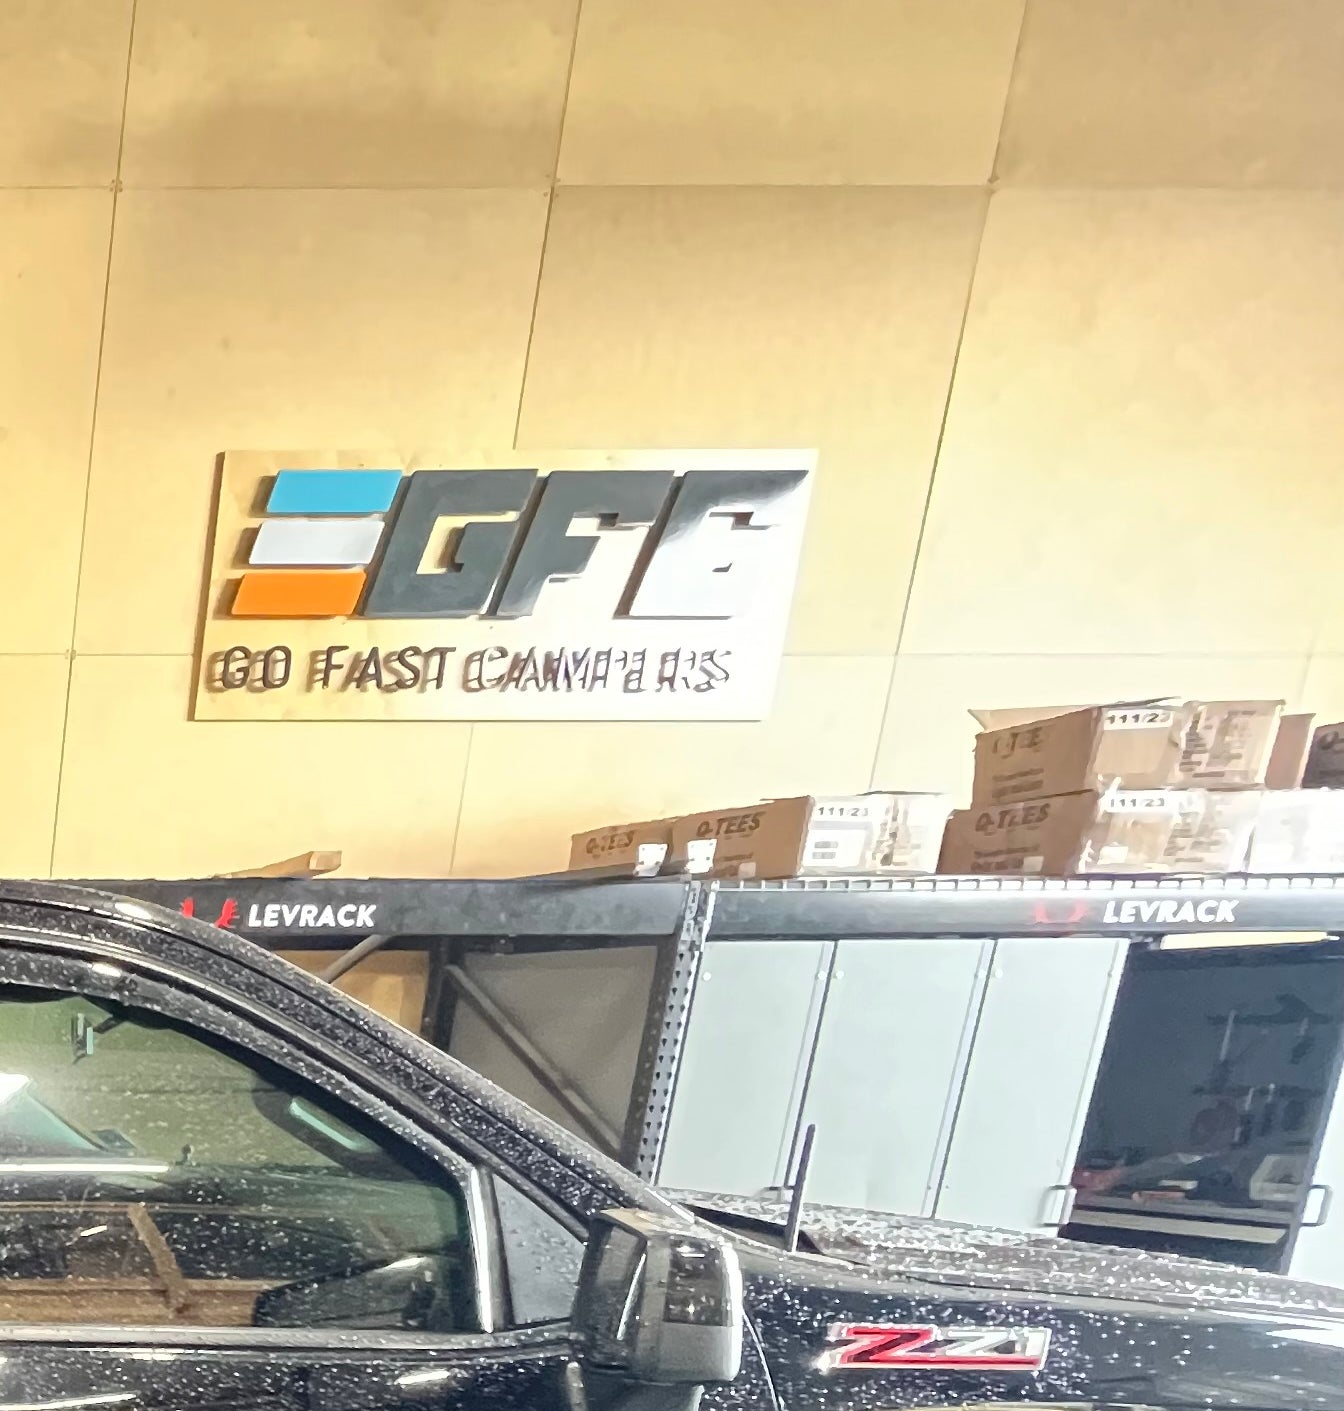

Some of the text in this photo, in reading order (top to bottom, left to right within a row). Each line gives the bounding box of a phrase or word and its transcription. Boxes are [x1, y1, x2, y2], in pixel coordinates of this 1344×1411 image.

[214, 644, 292, 691] GO
[314, 644, 457, 692] FAST
[696, 810, 766, 837] Q-TEES
[247, 903, 377, 928] LEVRACK
[1102, 900, 1240, 923] LEVRACK
